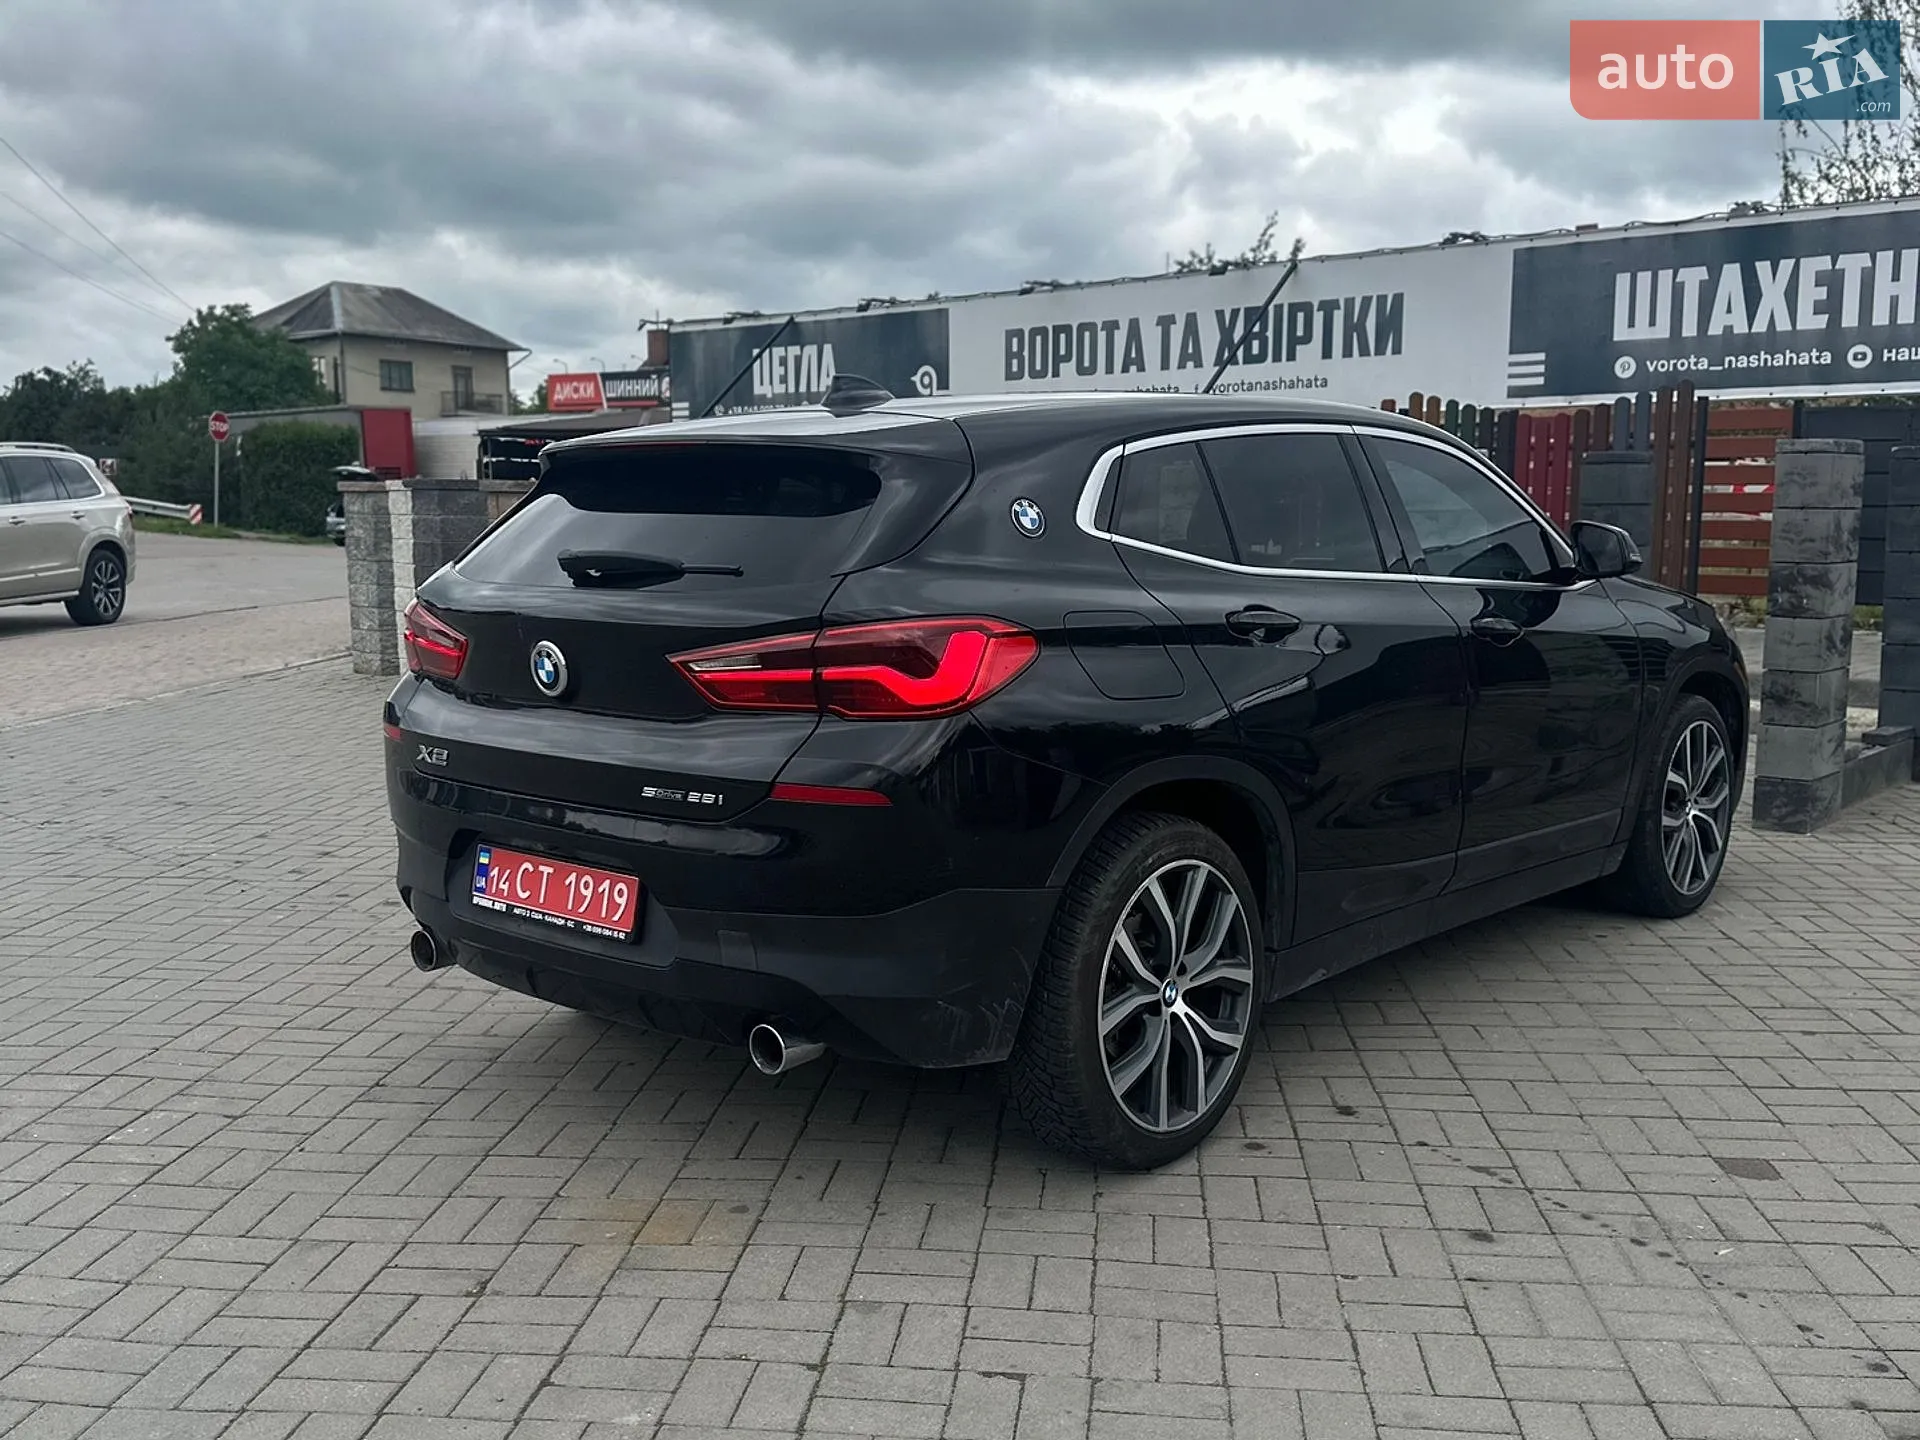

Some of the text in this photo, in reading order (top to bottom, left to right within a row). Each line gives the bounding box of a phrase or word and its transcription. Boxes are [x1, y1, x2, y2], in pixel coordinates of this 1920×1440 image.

[1004, 292, 1405, 381] ВОРОТА ТА ХВІРТКИ
[752, 343, 836, 398] ЦЕГЛА
[1646, 348, 1832, 373] vorota_nashahata
[554, 374, 659, 401] ДИСКИ ШИННИЙ
[209, 420, 229, 433] STOP
[416, 744, 449, 767] X2
[565, 872, 628, 921] 1919
